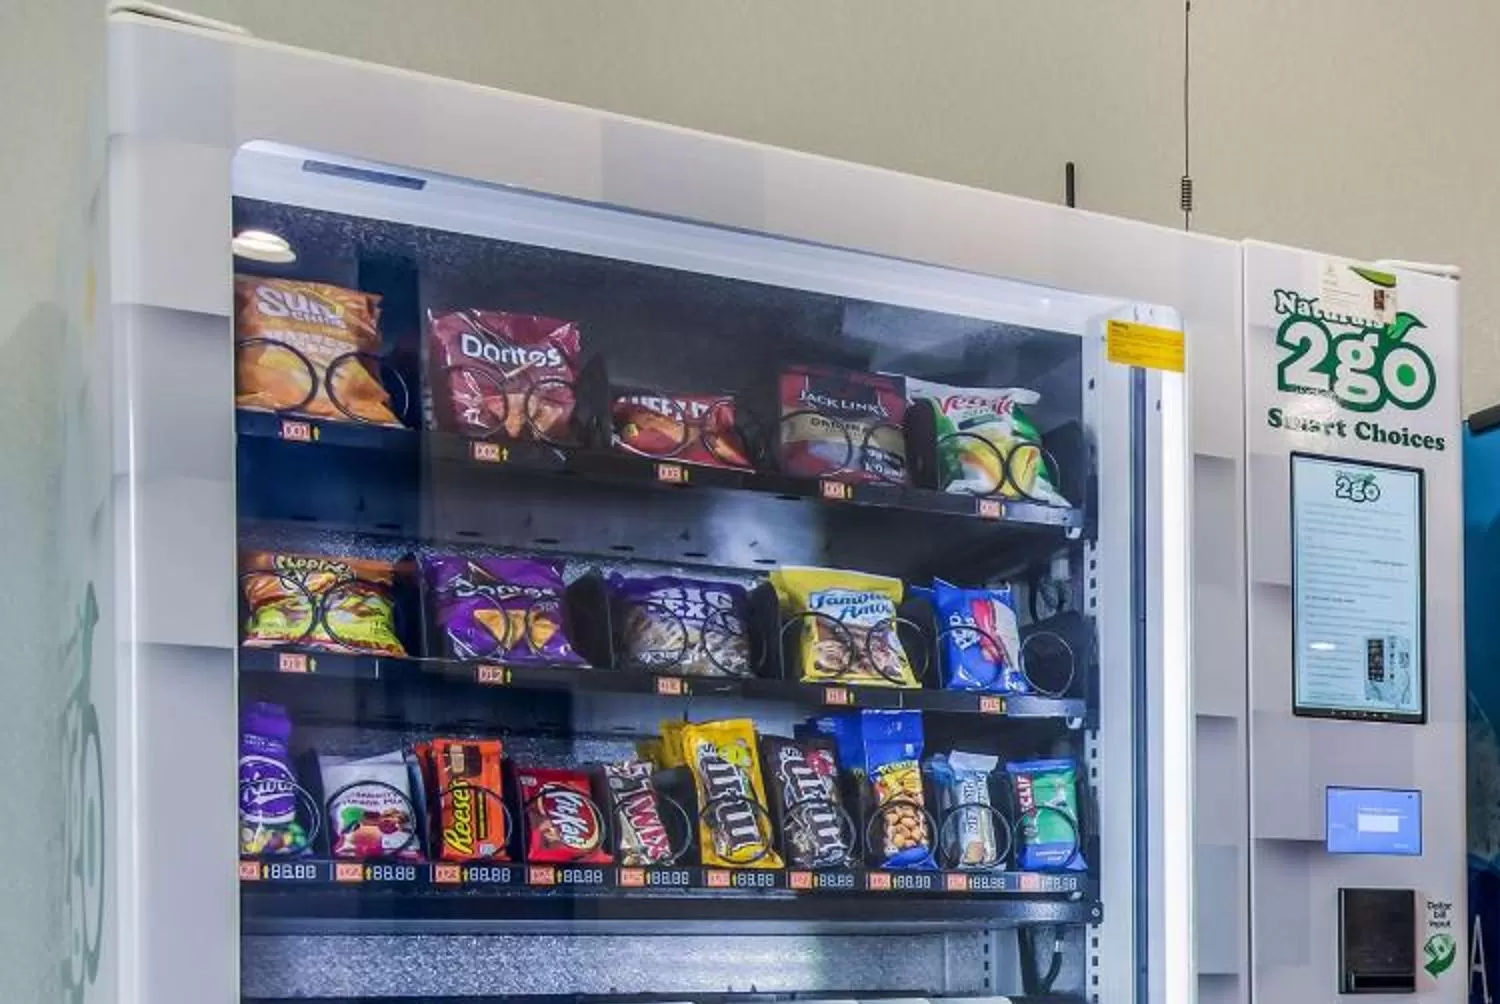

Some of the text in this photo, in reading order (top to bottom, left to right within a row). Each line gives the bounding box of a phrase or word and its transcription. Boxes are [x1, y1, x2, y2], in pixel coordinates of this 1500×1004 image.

[462, 333, 562, 367] Doritos
[1276, 316, 1437, 412] 2go
[1355, 421, 1445, 451] Choices
[1336, 476, 1381, 502] 2go
